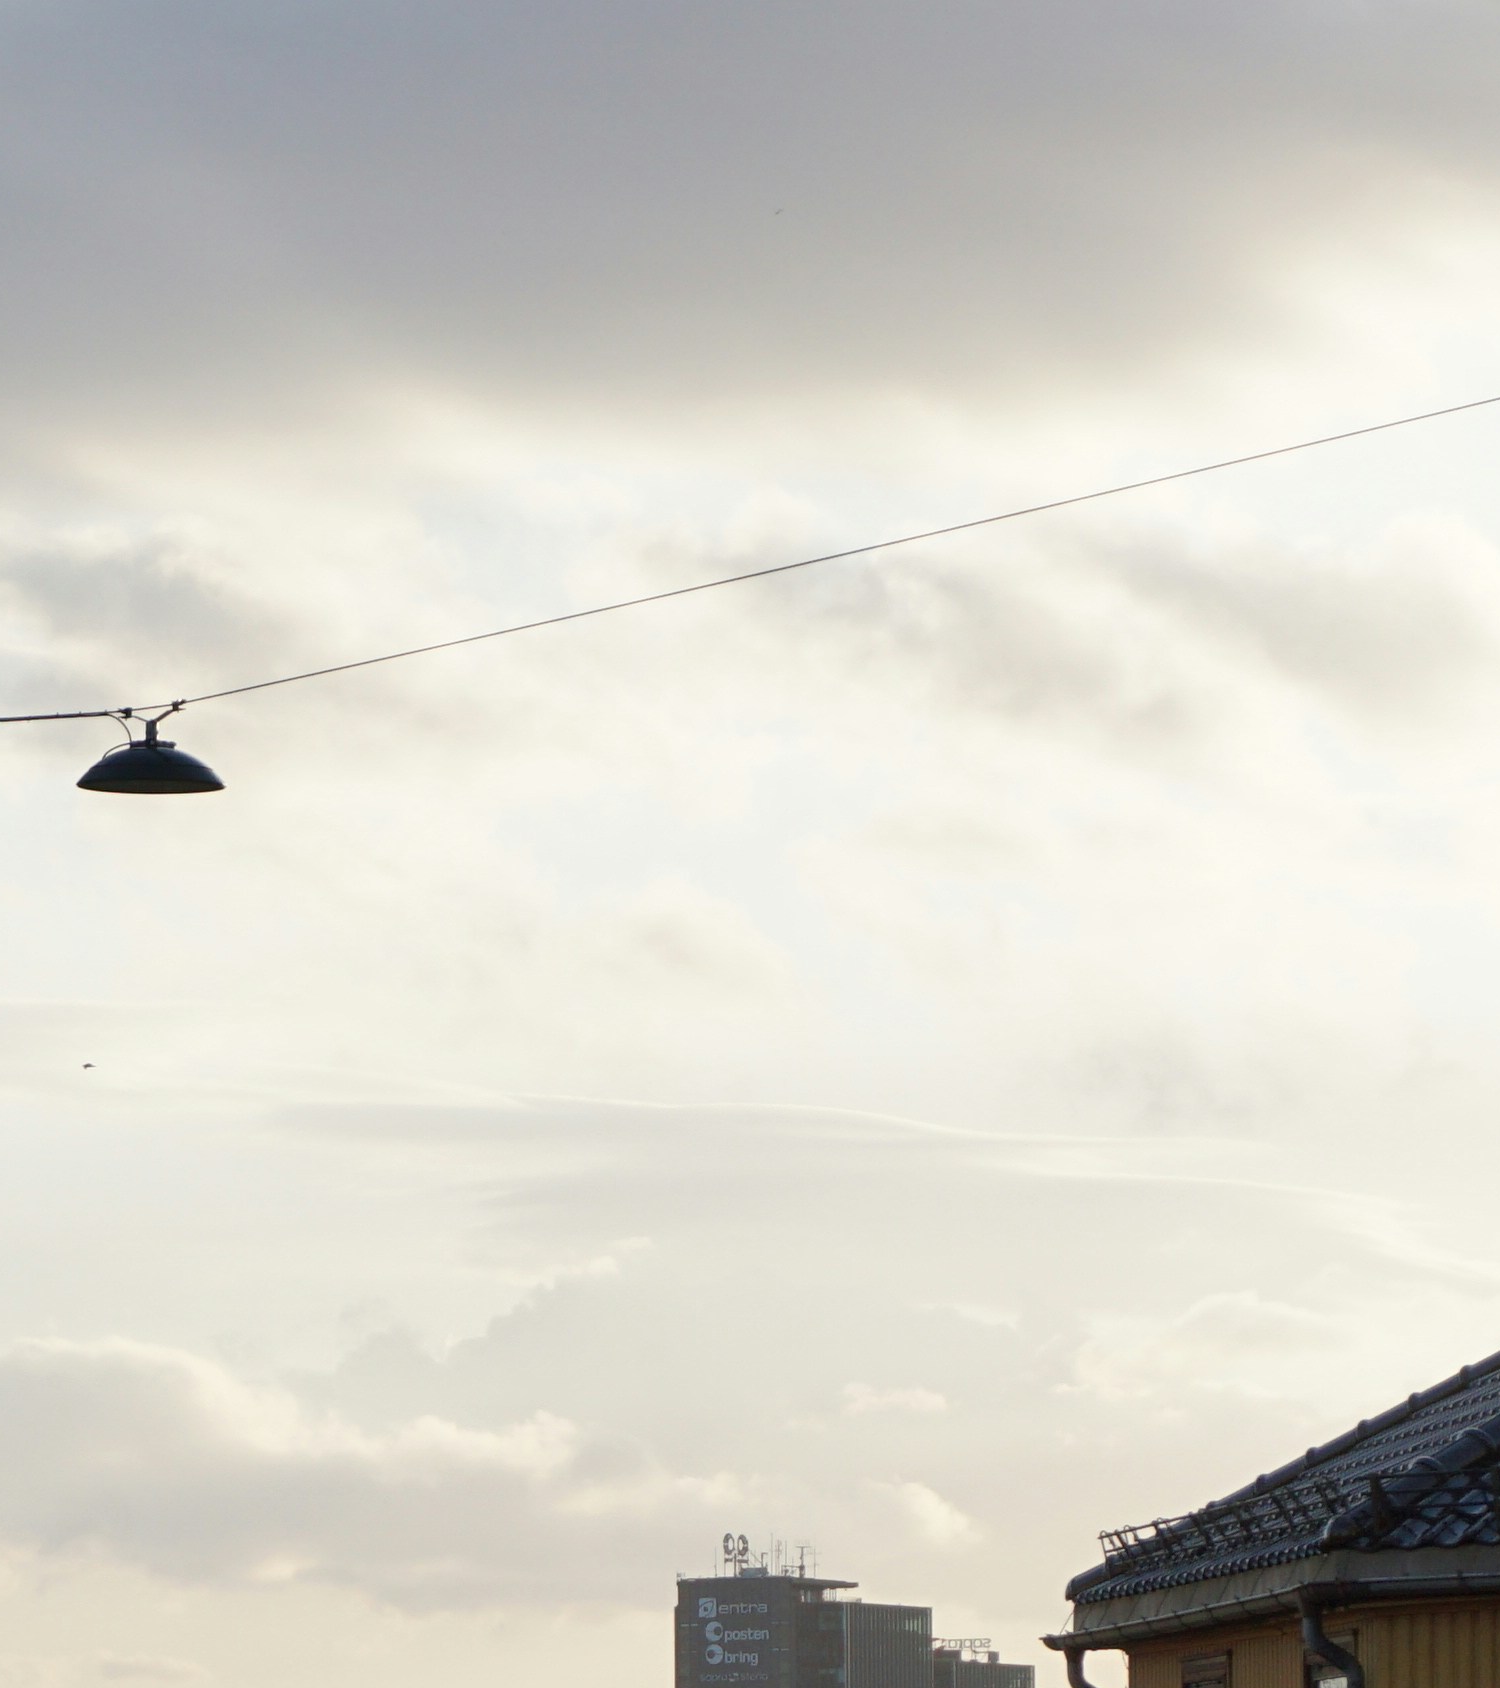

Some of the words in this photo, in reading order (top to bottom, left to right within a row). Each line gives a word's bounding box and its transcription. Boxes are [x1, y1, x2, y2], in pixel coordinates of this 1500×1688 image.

[719, 1602, 768, 1614] entra
[724, 1628, 769, 1643] posten
[725, 1651, 759, 1666] bring
